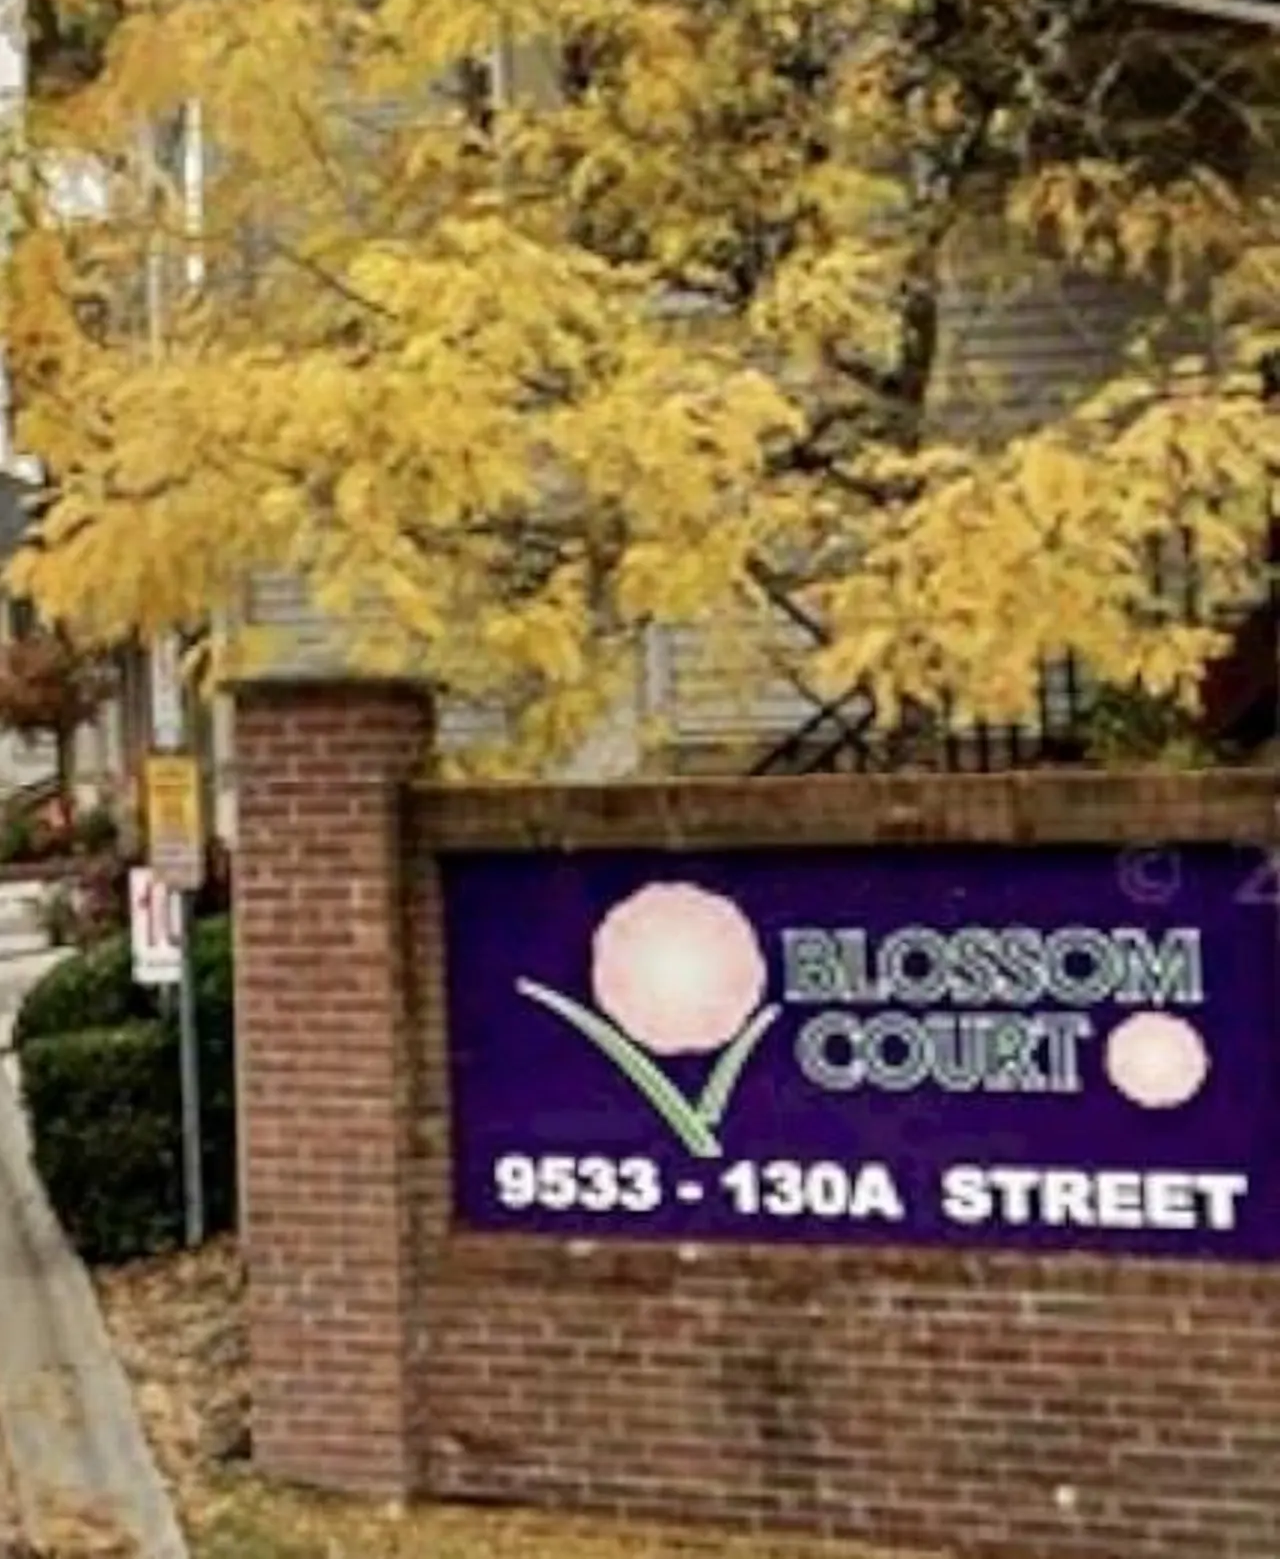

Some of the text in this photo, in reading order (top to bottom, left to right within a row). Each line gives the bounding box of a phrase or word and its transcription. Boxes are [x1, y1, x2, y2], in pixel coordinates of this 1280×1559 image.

[781, 927, 1203, 1005] BLOSSOM
[795, 1010, 1093, 1092] COURT
[494, 1154, 662, 1212] 9533
[720, 1159, 905, 1219] 130A
[941, 1165, 1248, 1230] STREET
